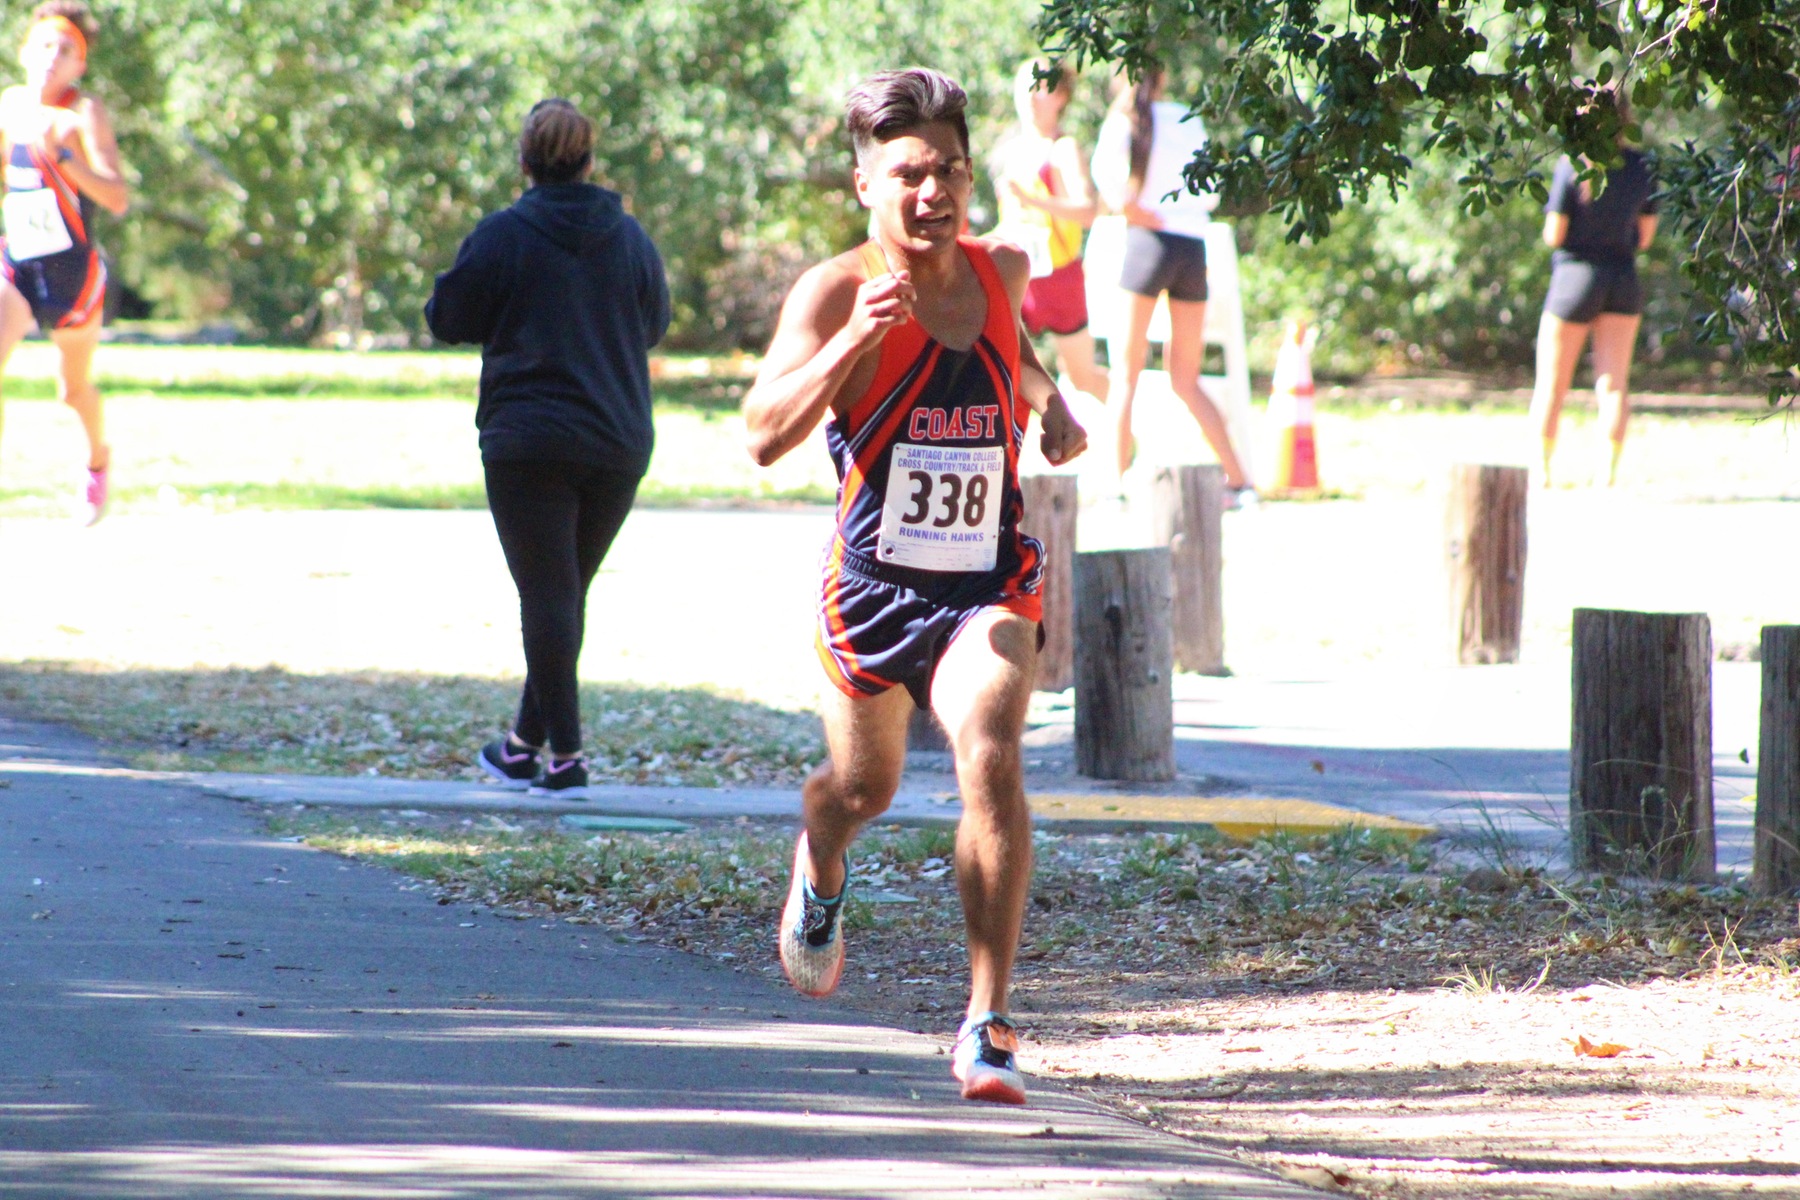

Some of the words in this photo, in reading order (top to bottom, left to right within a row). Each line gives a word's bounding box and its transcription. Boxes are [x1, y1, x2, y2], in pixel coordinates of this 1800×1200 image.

[908, 404, 999, 441] COAST
[907, 448, 942, 460] SANTIAGO
[944, 451, 971, 461] CANYON
[973, 451, 997, 462] COLLEGE
[897, 458, 922, 470] CROSS
[924, 460, 979, 472] COUNTRY/TRACK
[987, 462, 1002, 472] FIELD
[901, 470, 989, 528] 338
[898, 526, 947, 541] RUNNING
[951, 532, 985, 542] HAWKS
